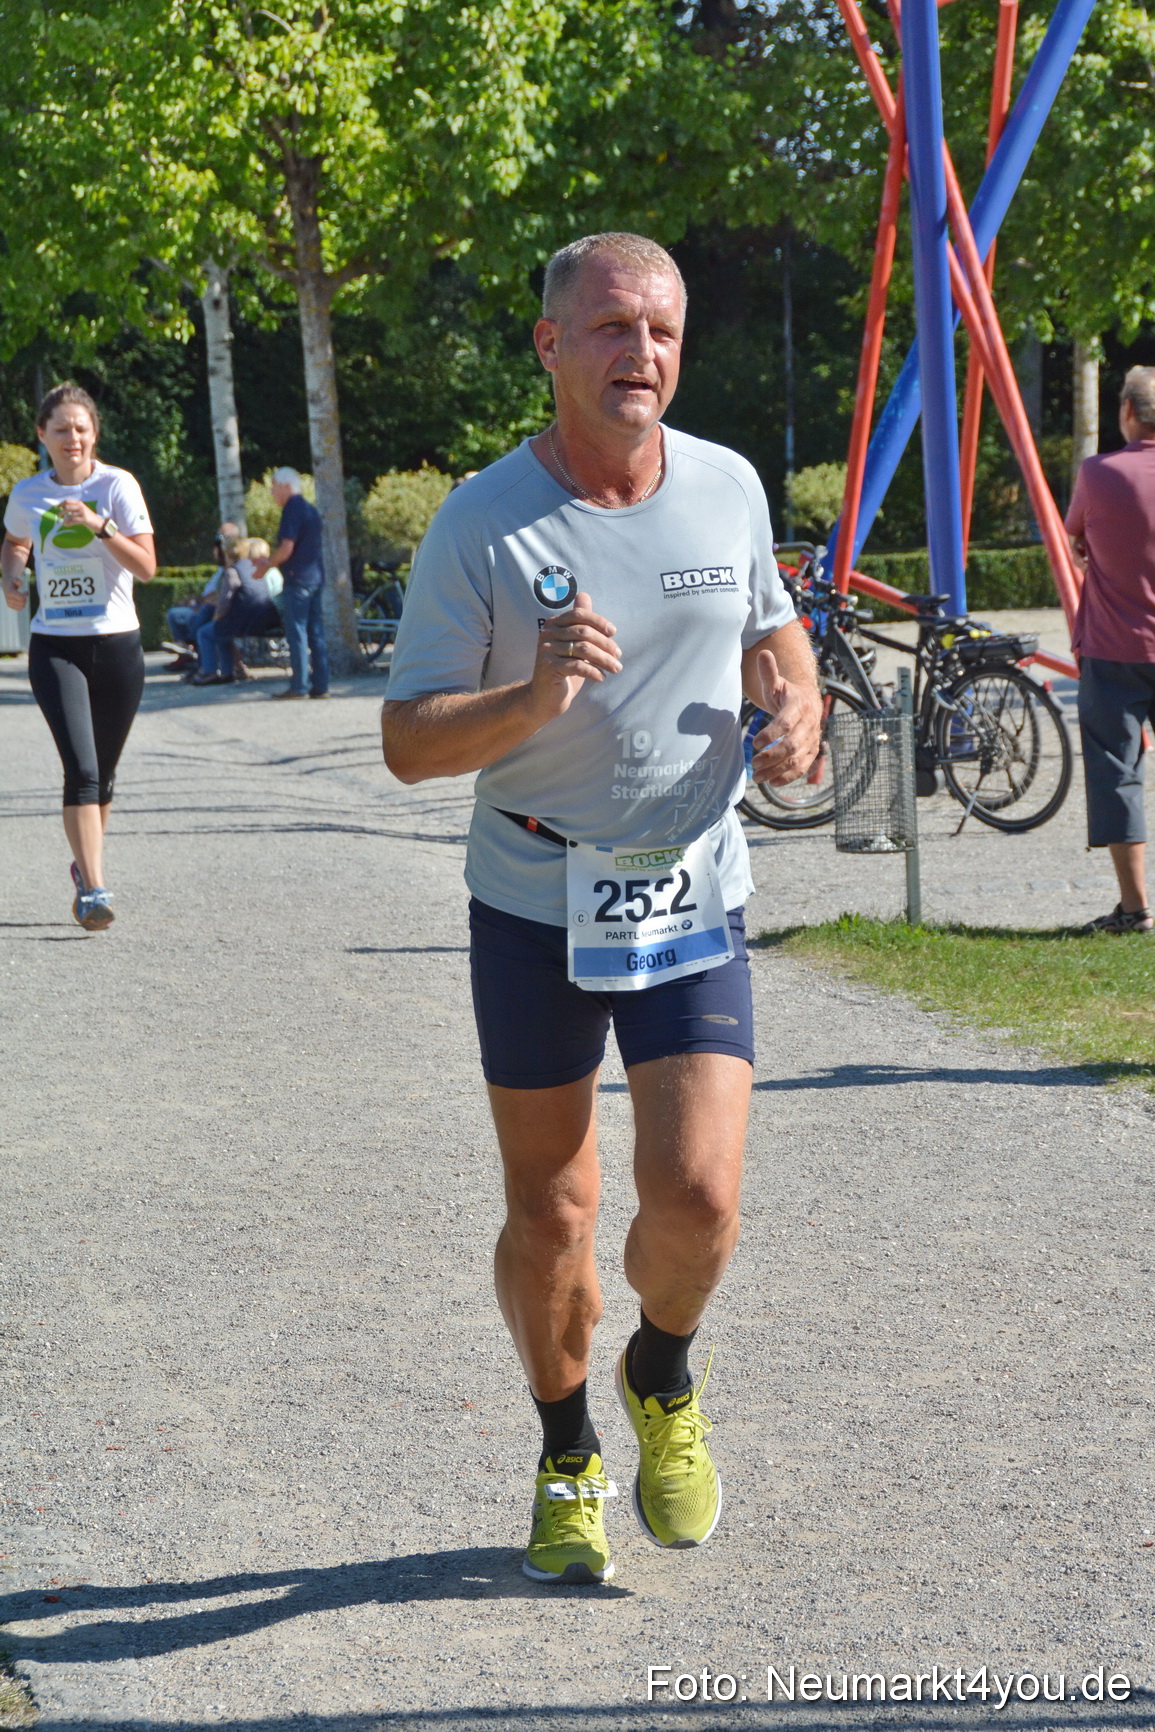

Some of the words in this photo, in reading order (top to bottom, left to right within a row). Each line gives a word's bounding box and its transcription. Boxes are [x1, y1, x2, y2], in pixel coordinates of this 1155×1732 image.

[537, 565, 573, 582] BMW
[660, 566, 738, 592] BOCK
[48, 577, 95, 598] 2253
[663, 590, 691, 600] inspired
[691, 588, 700, 596] by
[64, 608, 83, 617] Nina
[616, 729, 661, 759] 19.
[614, 758, 708, 779] Neumarkter
[611, 780, 691, 800] Stadtlauf
[616, 848, 684, 868] BOCK
[593, 868, 698, 923] 2522
[605, 931, 640, 940] PARTL
[626, 948, 677, 971] Georg
